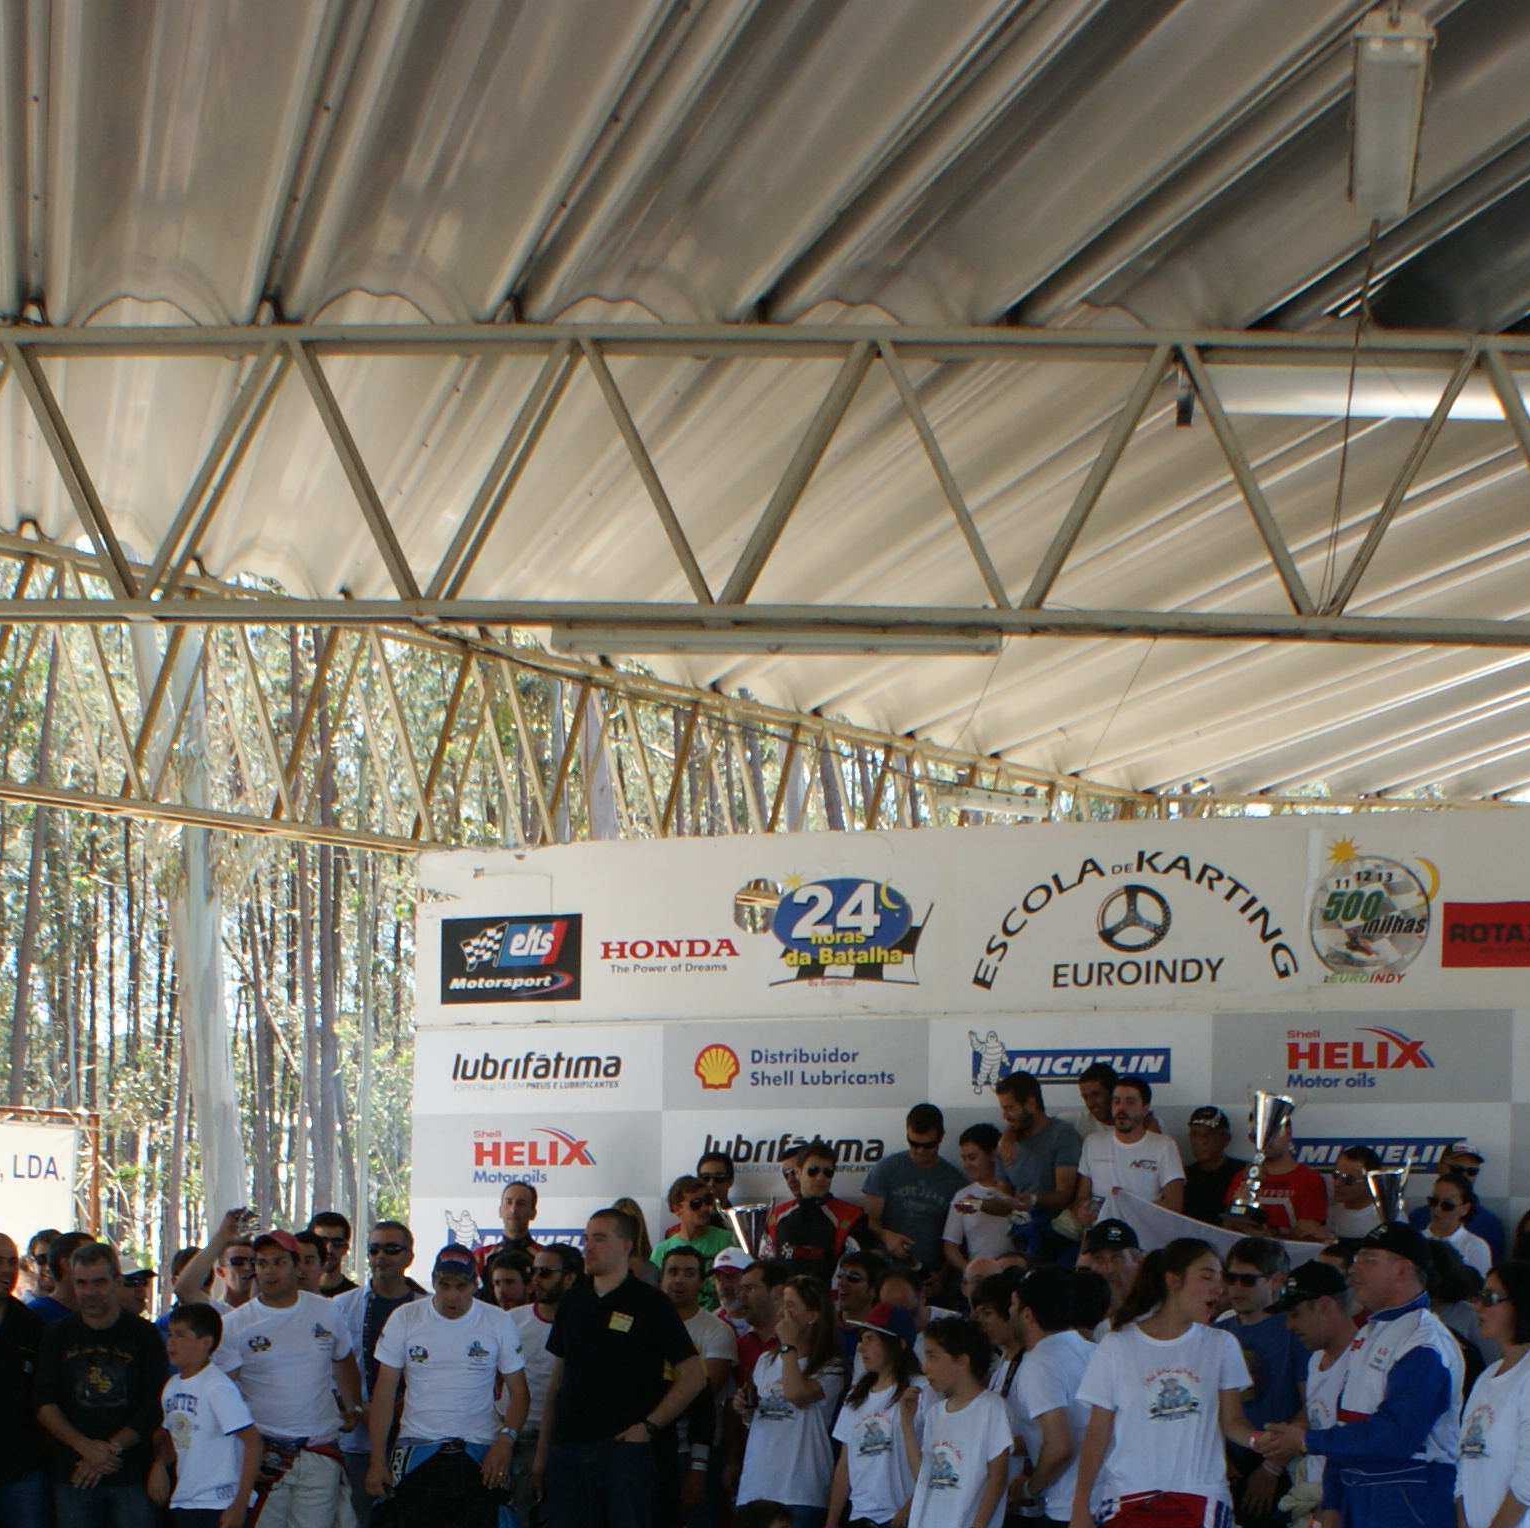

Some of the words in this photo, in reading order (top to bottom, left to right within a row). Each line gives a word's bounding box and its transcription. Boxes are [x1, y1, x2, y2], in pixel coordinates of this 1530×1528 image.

[1335, 878, 1350, 889] 11
[1355, 871, 1371, 882] 12
[1377, 871, 1392, 883] 13
[791, 882, 881, 939] 24
[1322, 890, 1385, 922] 500
[972, 857, 1106, 991] ESCOLA
[1111, 863, 1133, 875] DE
[1135, 850, 1299, 980] KARTING
[1362, 914, 1427, 935] milhas
[810, 931, 866, 944] horas
[600, 938, 740, 960] HONDA
[785, 949, 811, 967] da
[819, 947, 903, 965] Batalha
[610, 964, 630, 974] The
[633, 964, 667, 974] Power
[670, 963, 682, 973] of
[685, 963, 727, 973] Dreams
[1052, 957, 1225, 989] EUROINDY
[449, 976, 553, 991] Motorsport
[1328, 973, 1406, 985] EUROINDY
[1286, 1030, 1320, 1039] Shell
[751, 1048, 859, 1065] Distribuidor
[1286, 1040, 1433, 1070] HELIX
[750, 1069, 794, 1087] Shell
[801, 1068, 895, 1087] Lubricants
[1286, 1074, 1341, 1088] Motor
[1345, 1072, 1376, 1088] oils
[473, 1130, 502, 1139] Shell
[473, 1140, 598, 1167] HELIX
[704, 1133, 885, 1163] lubrifma
[12, 1154, 67, 1182] LDA.
[473, 1171, 519, 1183] Motor
[522, 1169, 547, 1183] oils
